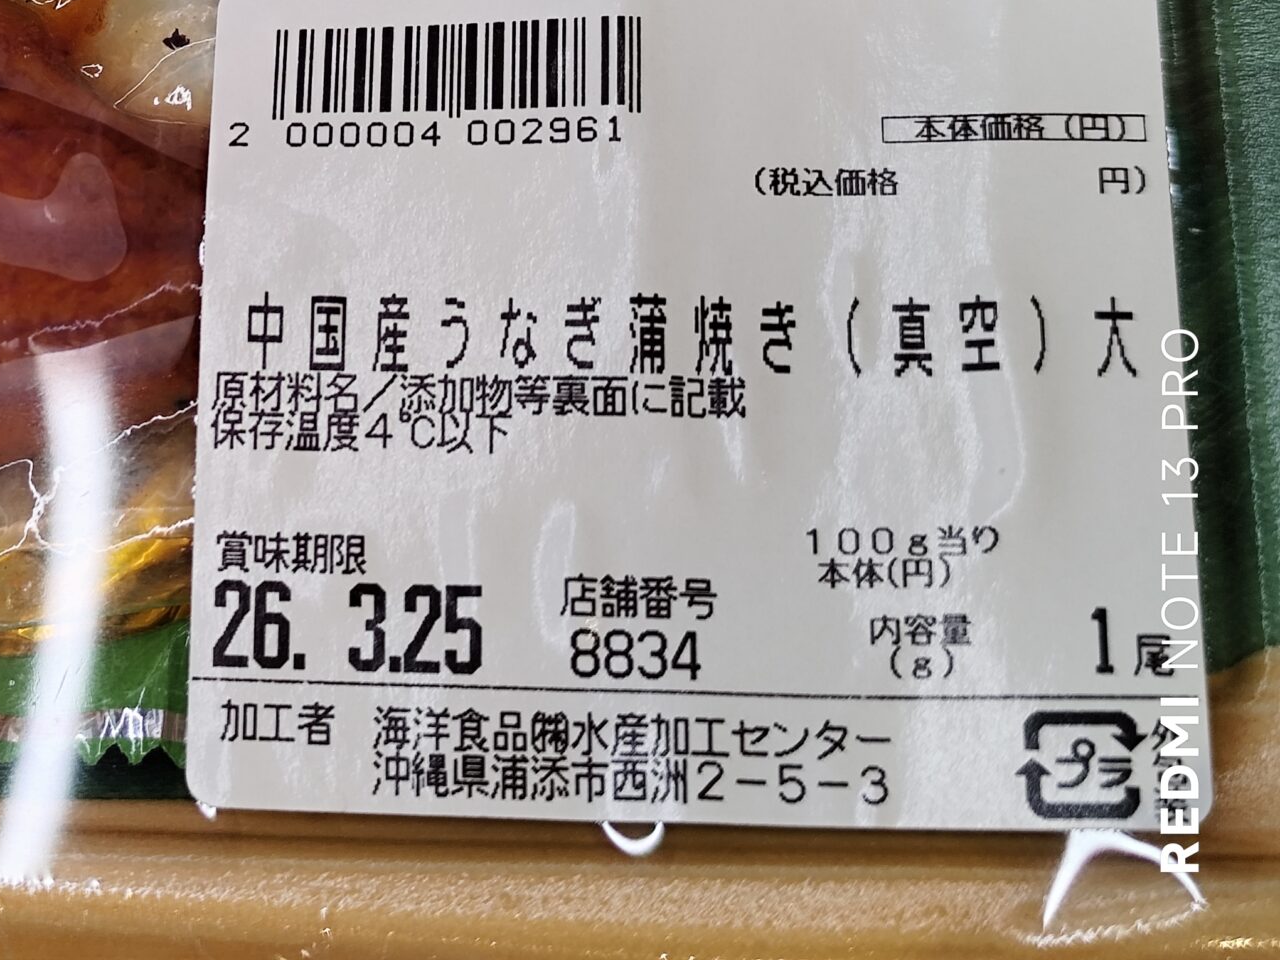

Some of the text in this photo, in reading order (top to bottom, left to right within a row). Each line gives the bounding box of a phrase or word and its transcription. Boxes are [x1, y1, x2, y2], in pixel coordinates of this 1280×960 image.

[228, 115, 622, 147] 2 000004 002961
[216, 530, 367, 576] 賞味期限
[560, 572, 718, 621] 店舗番号
[870, 614, 972, 646] 内容量
[570, 628, 702, 681] 8834
[220, 698, 335, 746] 加工者
